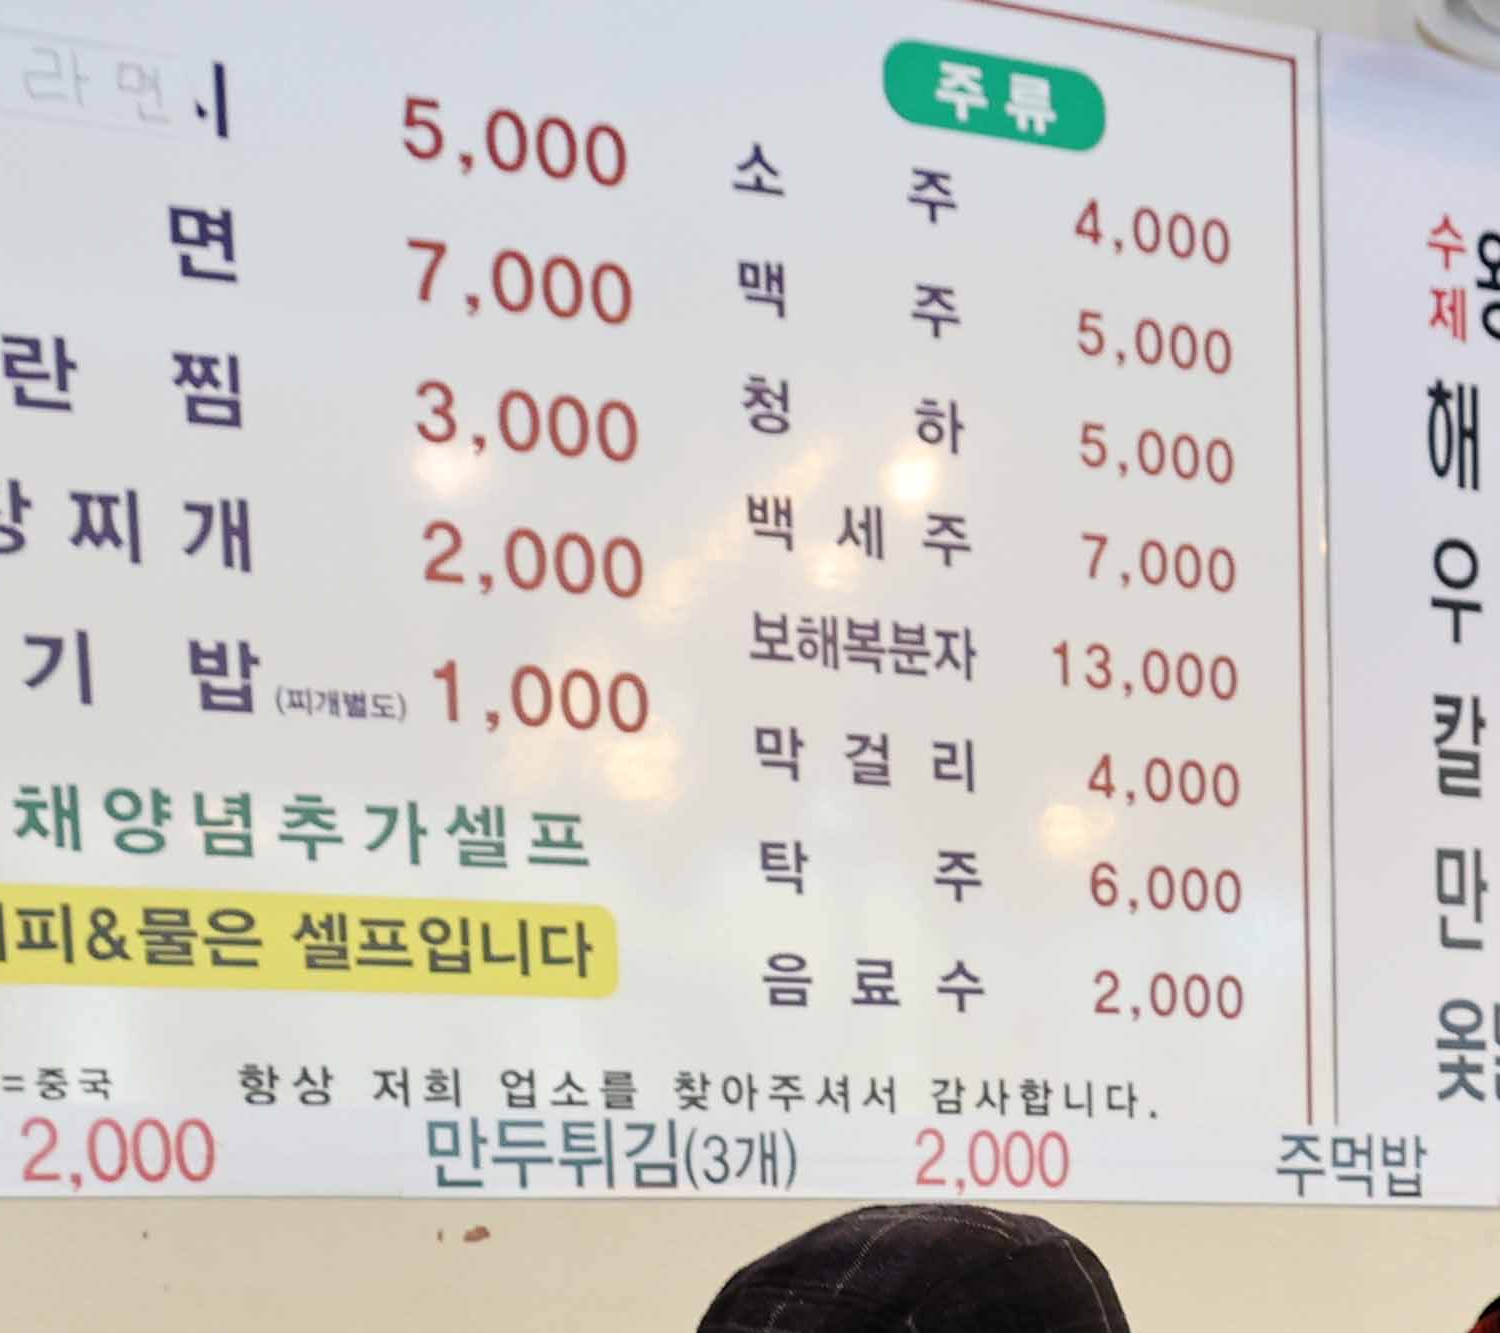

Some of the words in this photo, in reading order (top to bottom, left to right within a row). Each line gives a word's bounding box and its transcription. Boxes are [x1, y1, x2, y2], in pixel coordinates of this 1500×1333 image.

[933, 58, 1058, 137] 주류
[402, 95, 630, 188] 5,000
[1073, 197, 1232, 266] 4,000
[406, 238, 634, 326] 7,000
[1076, 309, 1234, 376] 5,000
[414, 380, 640, 464] 3,000
[1079, 421, 1236, 486] 5,000
[422, 519, 645, 600] 2,000
[746, 492, 973, 568] 백세주
[1079, 532, 1237, 594] 7,000
[748, 609, 978, 682] 보해복분자
[1051, 639, 1239, 702] 13,000
[431, 658, 651, 734] 1,000
[753, 724, 977, 793] 막걸리
[1086, 752, 1241, 808] 4,000
[1088, 861, 1243, 915] 6,000
[291, 911, 596, 981] 셀프입니다
[761, 952, 987, 1014] 음료수
[1092, 969, 1245, 1021] 2,000
[237, 1063, 336, 1106] 항상
[372, 1066, 463, 1109] 저희
[498, 1069, 639, 1111] 업소를
[672, 1070, 897, 1114] 찾아주셔서
[930, 1077, 1159, 1120] 감사합니다.
[20, 1115, 218, 1193] 2,000
[426, 1115, 799, 1190] 만두튀김(3개)
[914, 1127, 1072, 1193] 2,000
[1275, 1132, 1428, 1198] 주먹밥
